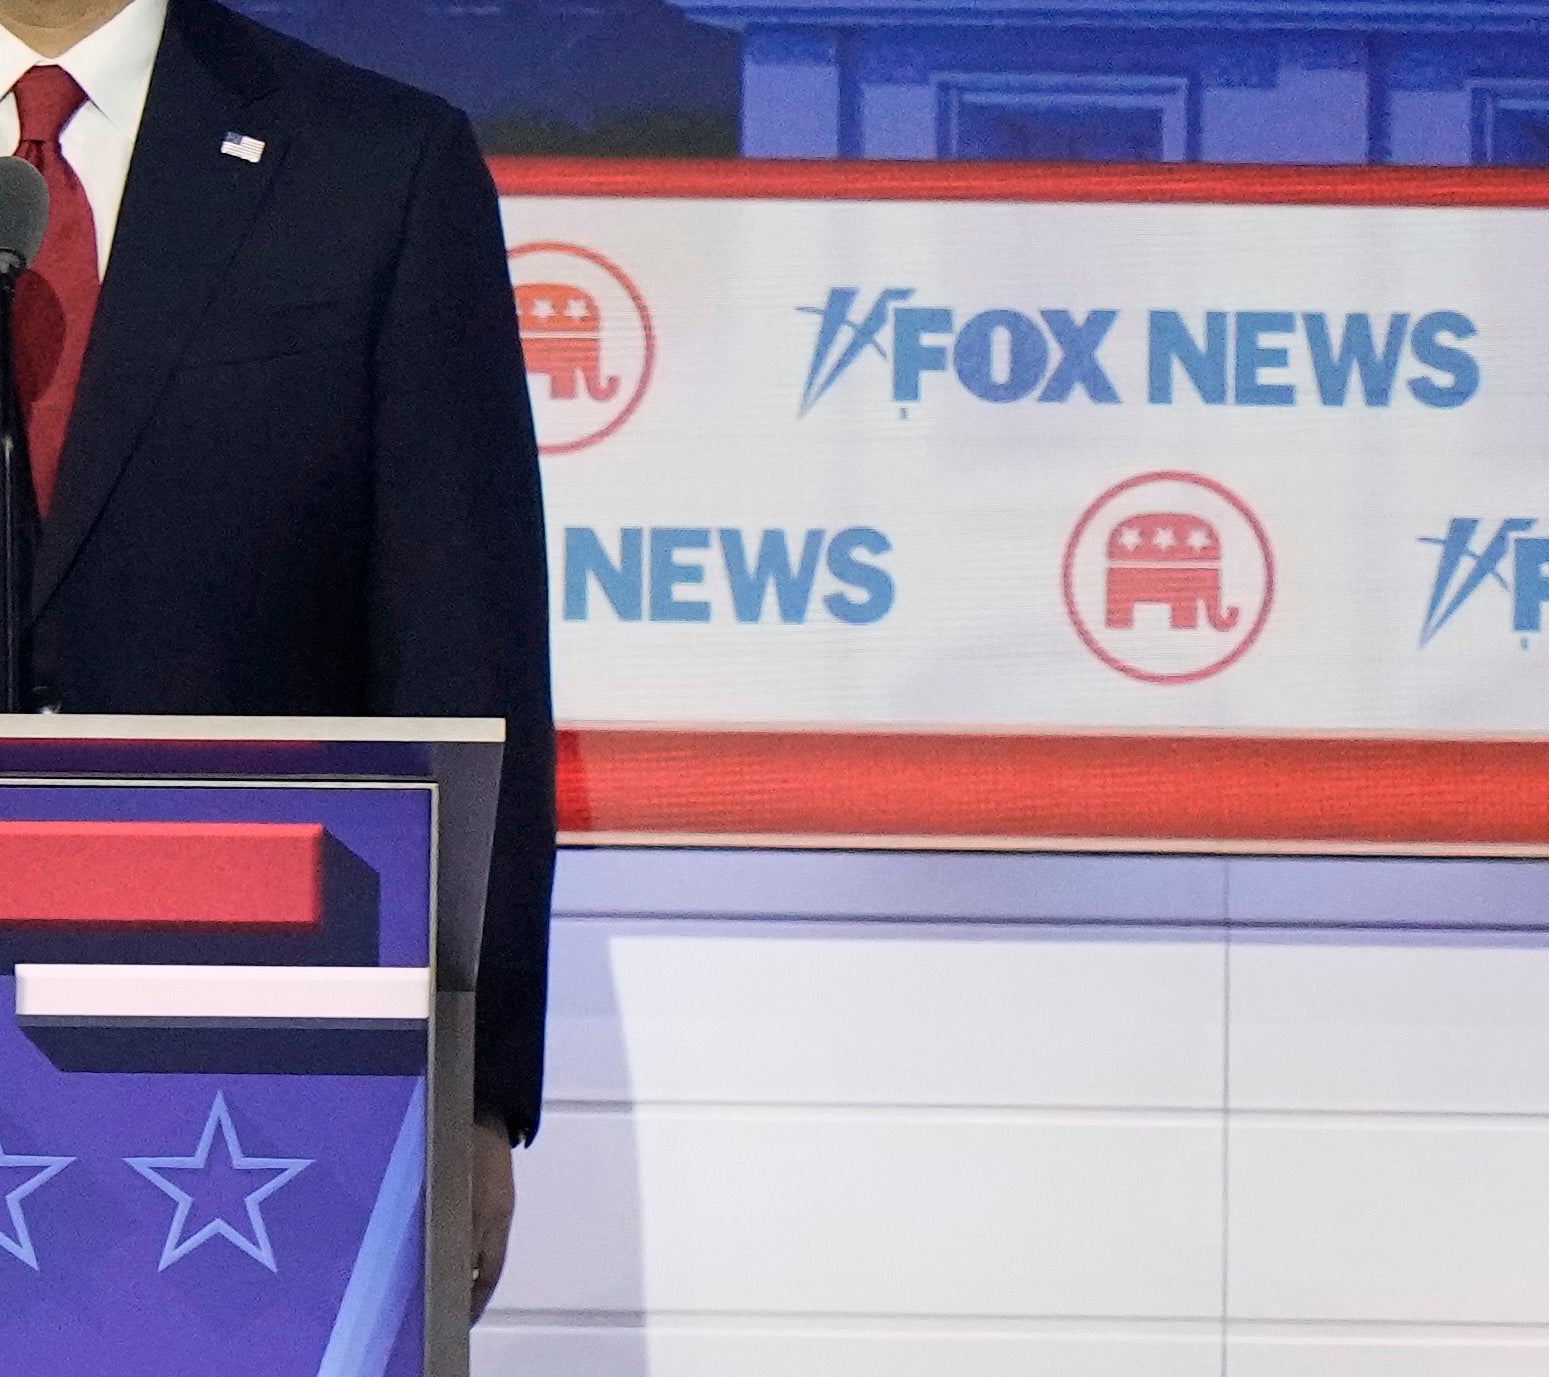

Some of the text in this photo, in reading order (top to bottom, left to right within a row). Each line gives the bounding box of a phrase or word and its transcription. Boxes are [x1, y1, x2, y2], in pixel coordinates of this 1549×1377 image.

[893, 307, 1480, 408] FOX NEWS
[564, 526, 895, 625] NEWS
